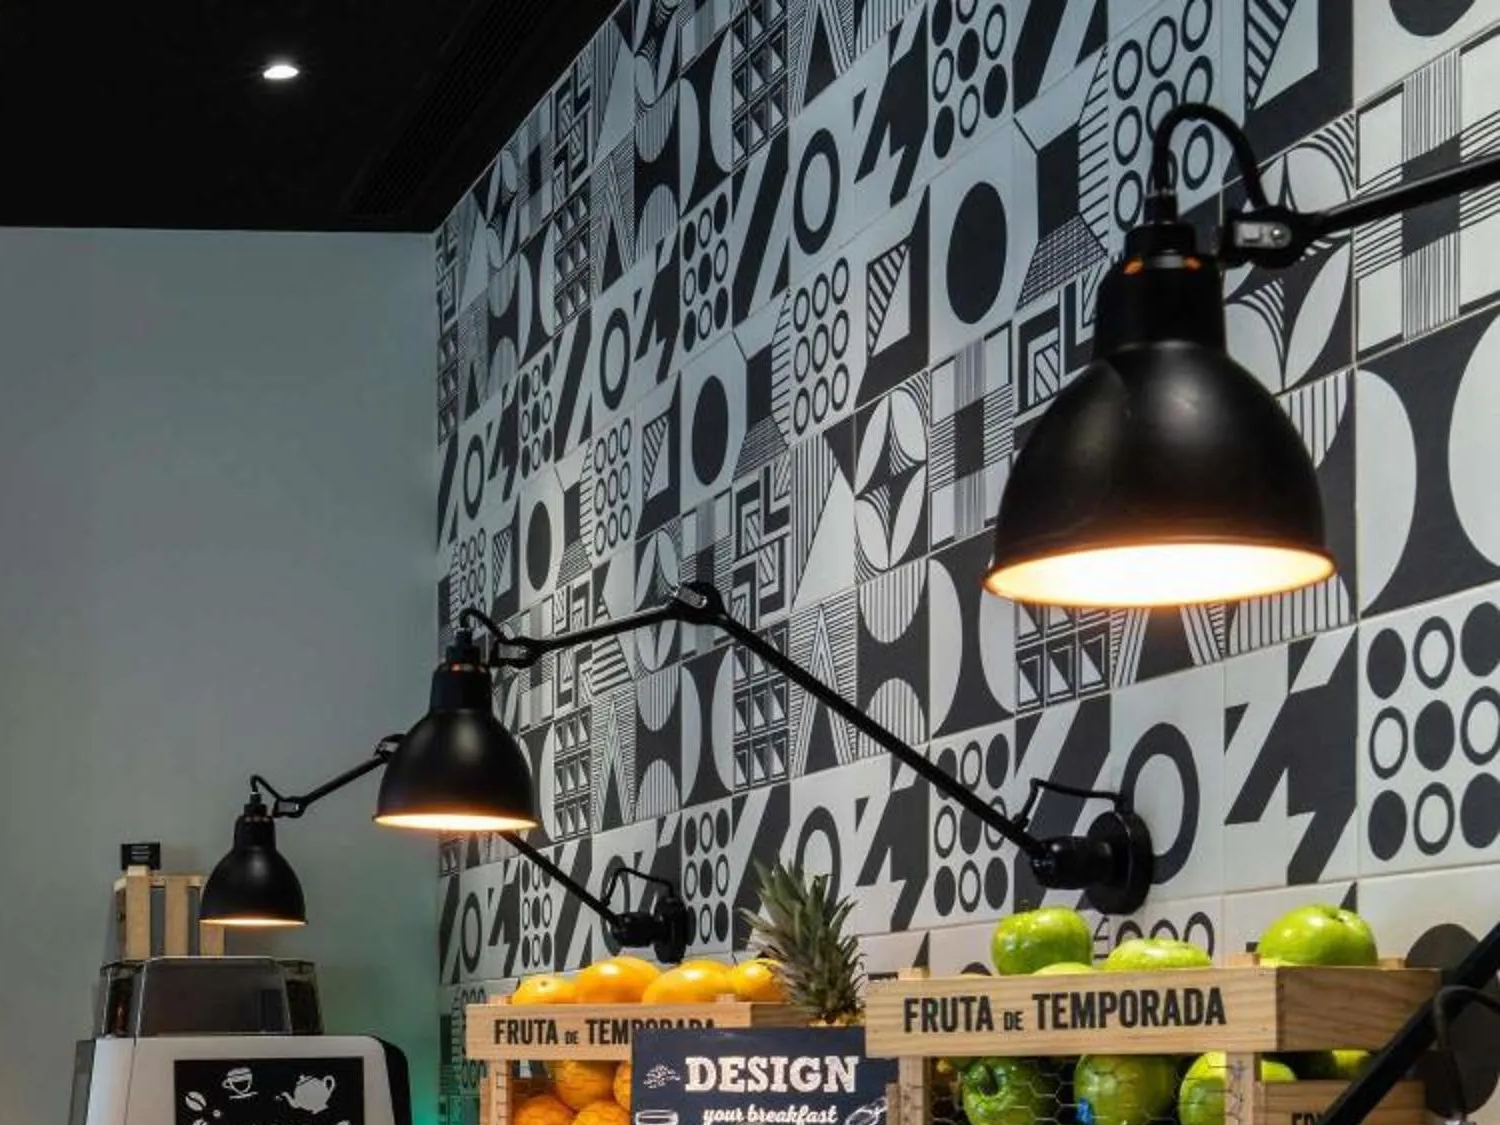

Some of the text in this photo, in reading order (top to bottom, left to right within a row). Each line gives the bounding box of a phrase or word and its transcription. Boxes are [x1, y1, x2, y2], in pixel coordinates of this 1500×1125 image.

[903, 986, 1227, 1033] FRUTA DE TEMPORADA
[493, 1018, 558, 1045] FRUTA
[564, 1030, 579, 1045] DE
[684, 1055, 860, 1094] DESIGN
